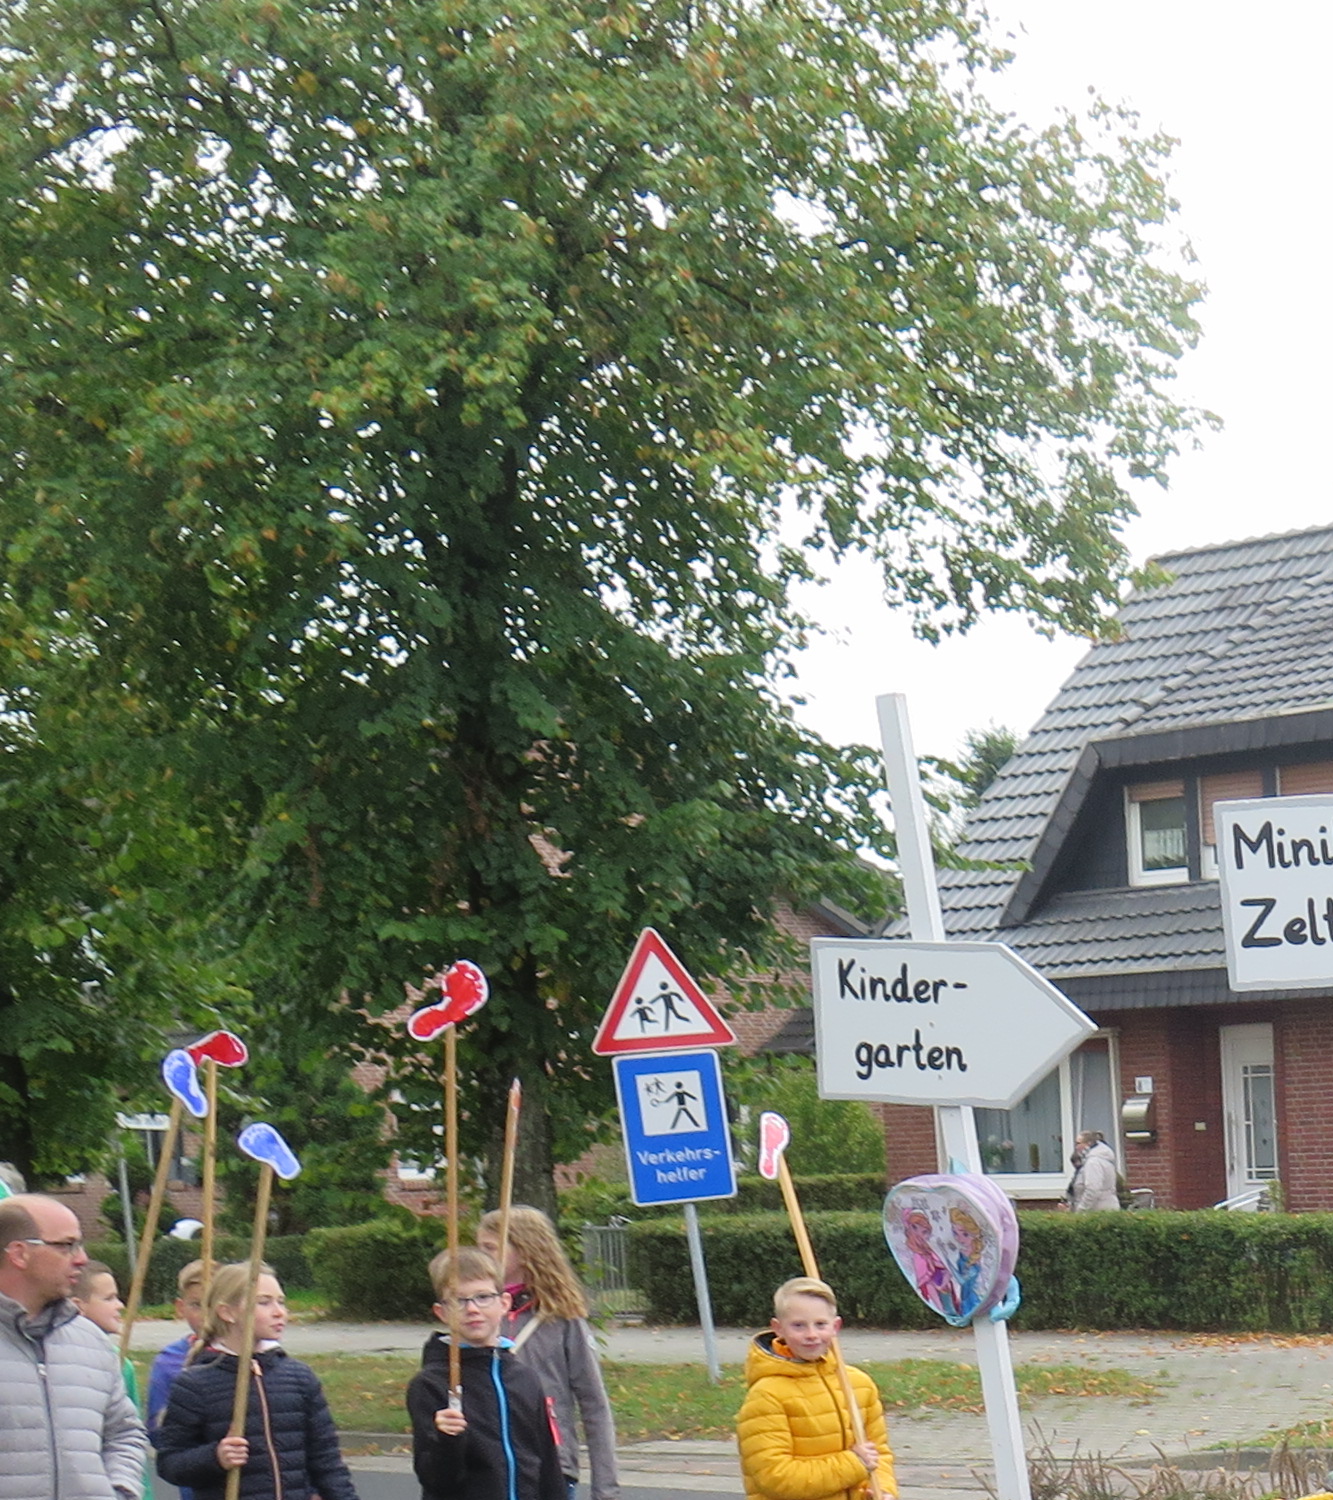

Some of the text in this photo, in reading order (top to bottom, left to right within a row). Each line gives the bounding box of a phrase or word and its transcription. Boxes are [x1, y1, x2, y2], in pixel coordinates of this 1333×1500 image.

[838, 958, 968, 1004] Kinder-
[855, 1028, 968, 1080] garten
[636, 1146, 722, 1166] Verkehrs-
[655, 1166, 708, 1184] helfer
